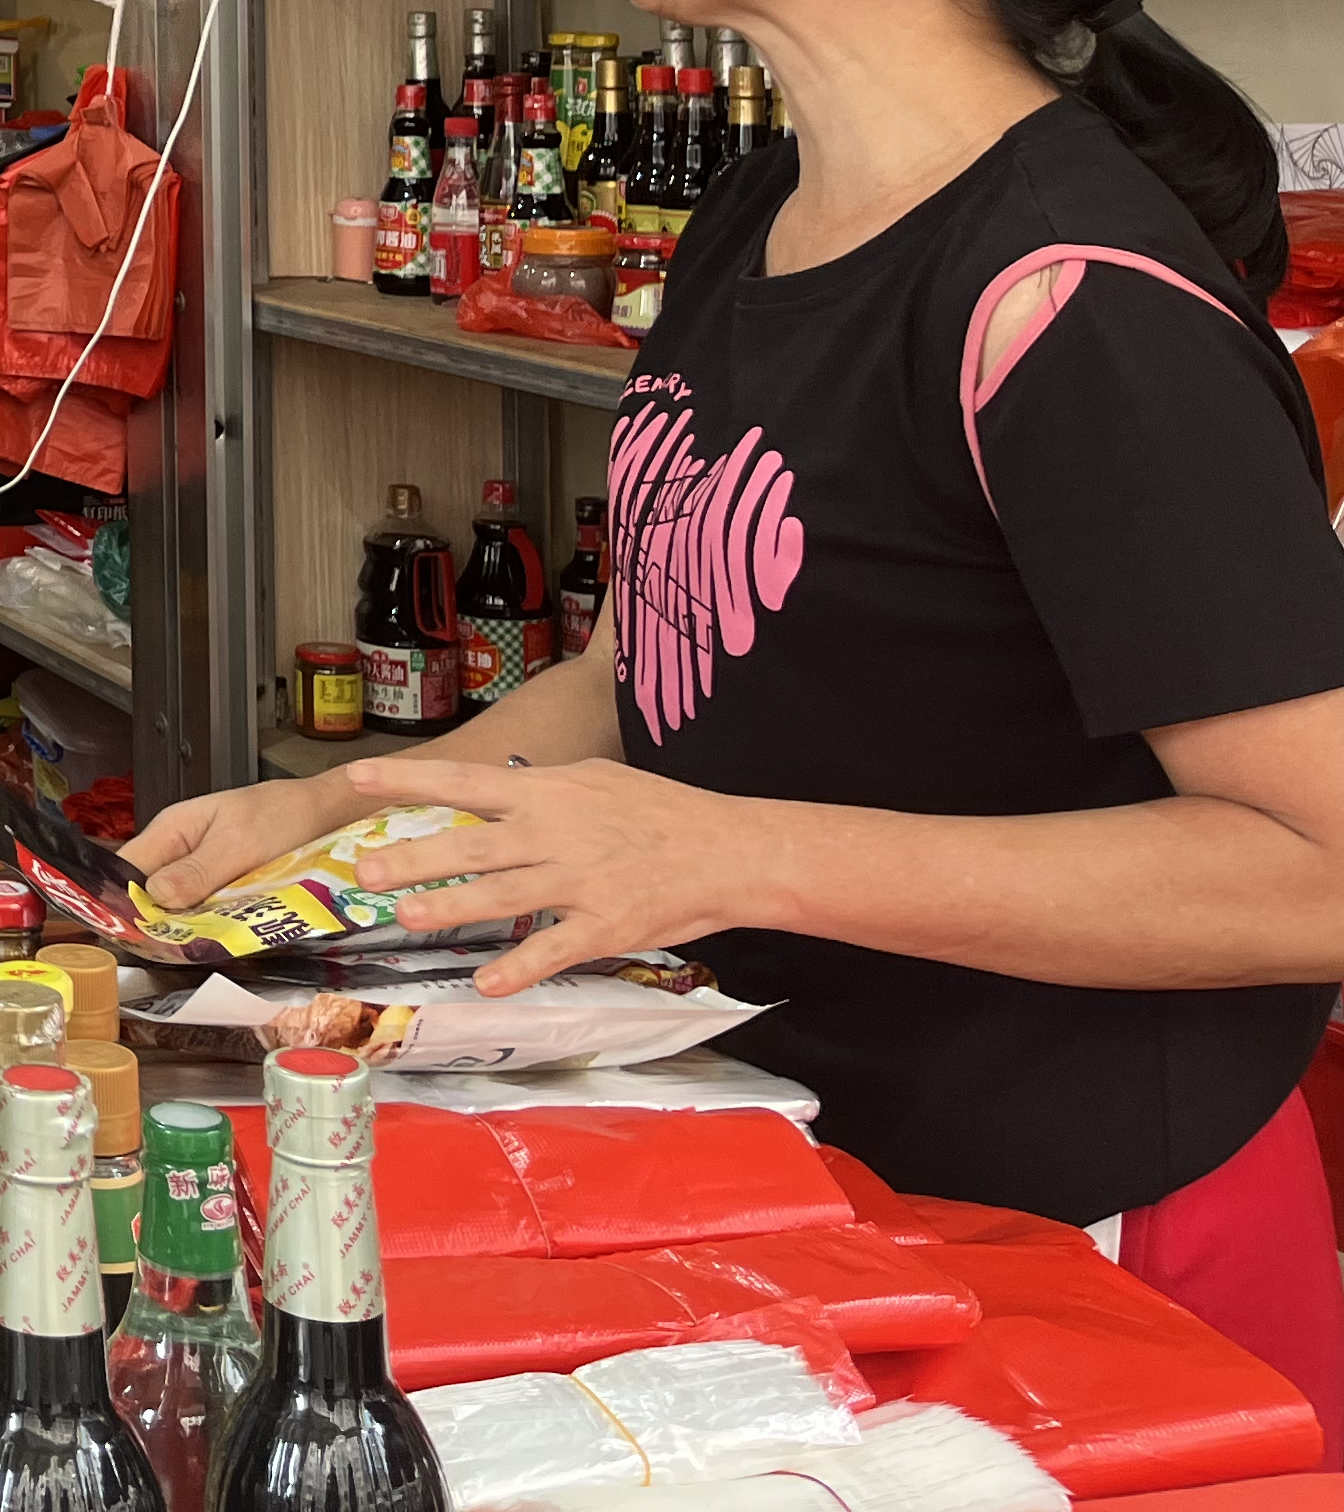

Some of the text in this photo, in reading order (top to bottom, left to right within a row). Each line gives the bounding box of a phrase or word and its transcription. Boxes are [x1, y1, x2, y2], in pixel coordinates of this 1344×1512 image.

[288, 1184, 313, 1210] CHAI
[338, 1214, 368, 1259] JAMMY
[62, 1268, 90, 1313] JAMMY
[287, 1270, 316, 1297] CHAI
